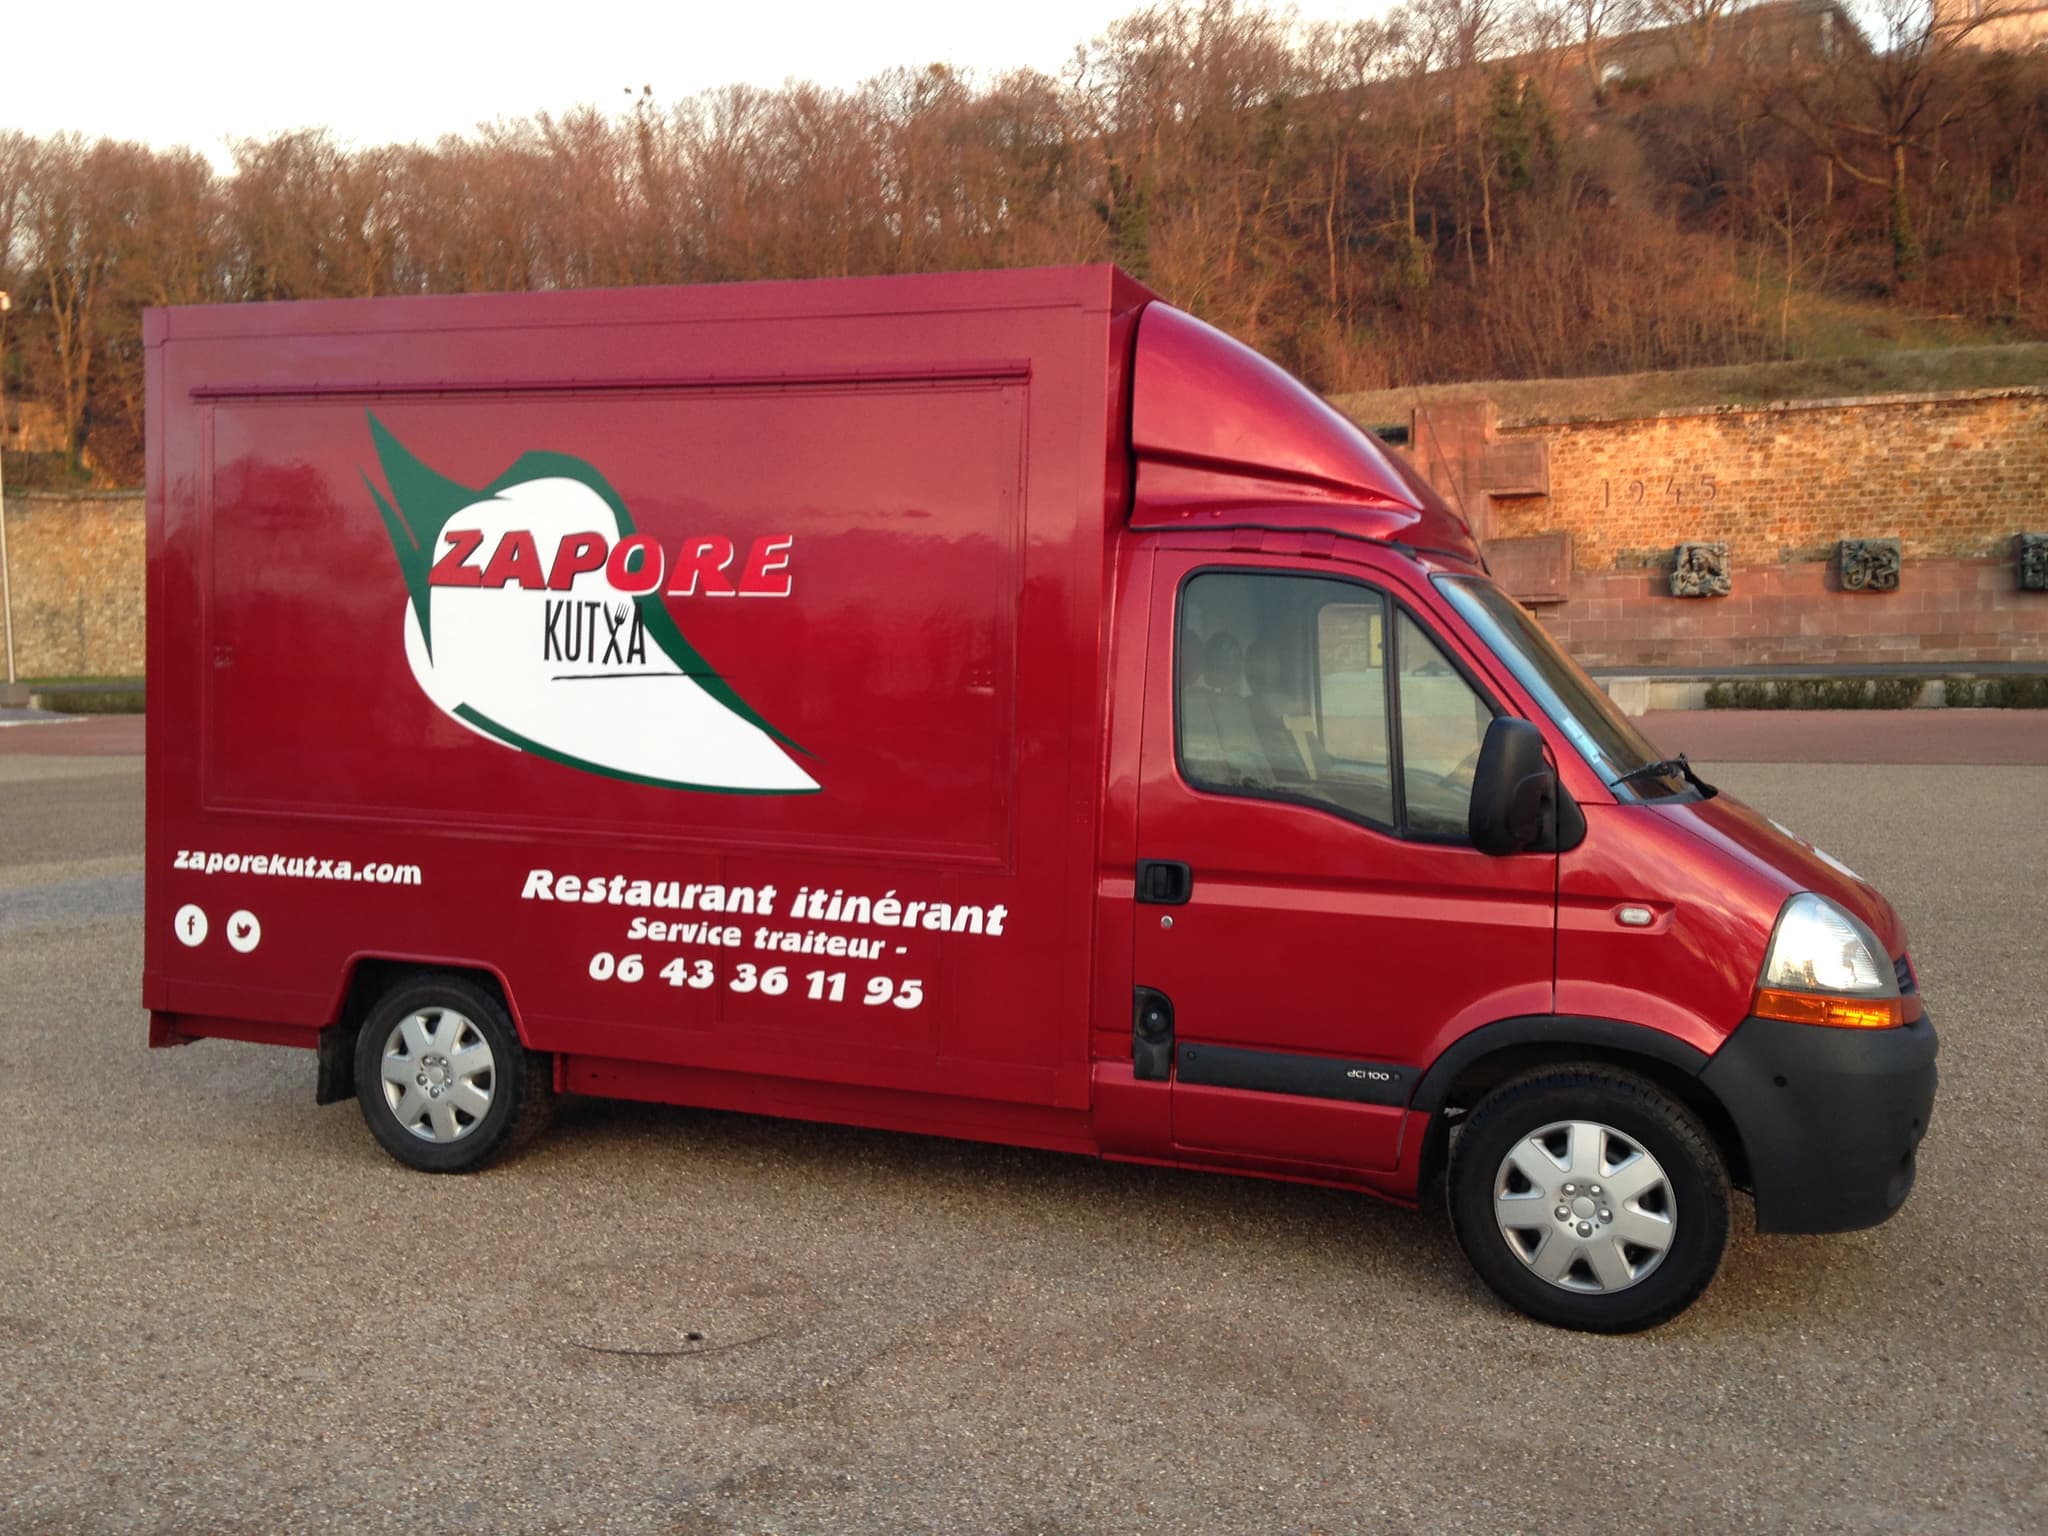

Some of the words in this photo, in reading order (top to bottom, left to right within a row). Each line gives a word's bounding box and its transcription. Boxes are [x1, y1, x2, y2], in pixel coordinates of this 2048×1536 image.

[1601, 474, 1716, 508] 1945
[428, 529, 793, 597] ZAPORE
[543, 599, 647, 665] KUTXA
[173, 850, 422, 885] zaporekutxa.com
[521, 868, 778, 918] Restaurant
[789, 885, 1009, 937] itinérant
[627, 916, 742, 947] Service
[754, 926, 886, 960] traiteur
[588, 951, 644, 983] 06
[659, 957, 715, 989] 43
[729, 963, 789, 996] 36
[806, 970, 847, 1002] 11
[863, 976, 924, 1010] 95
[1368, 1071, 1390, 1081] 100
